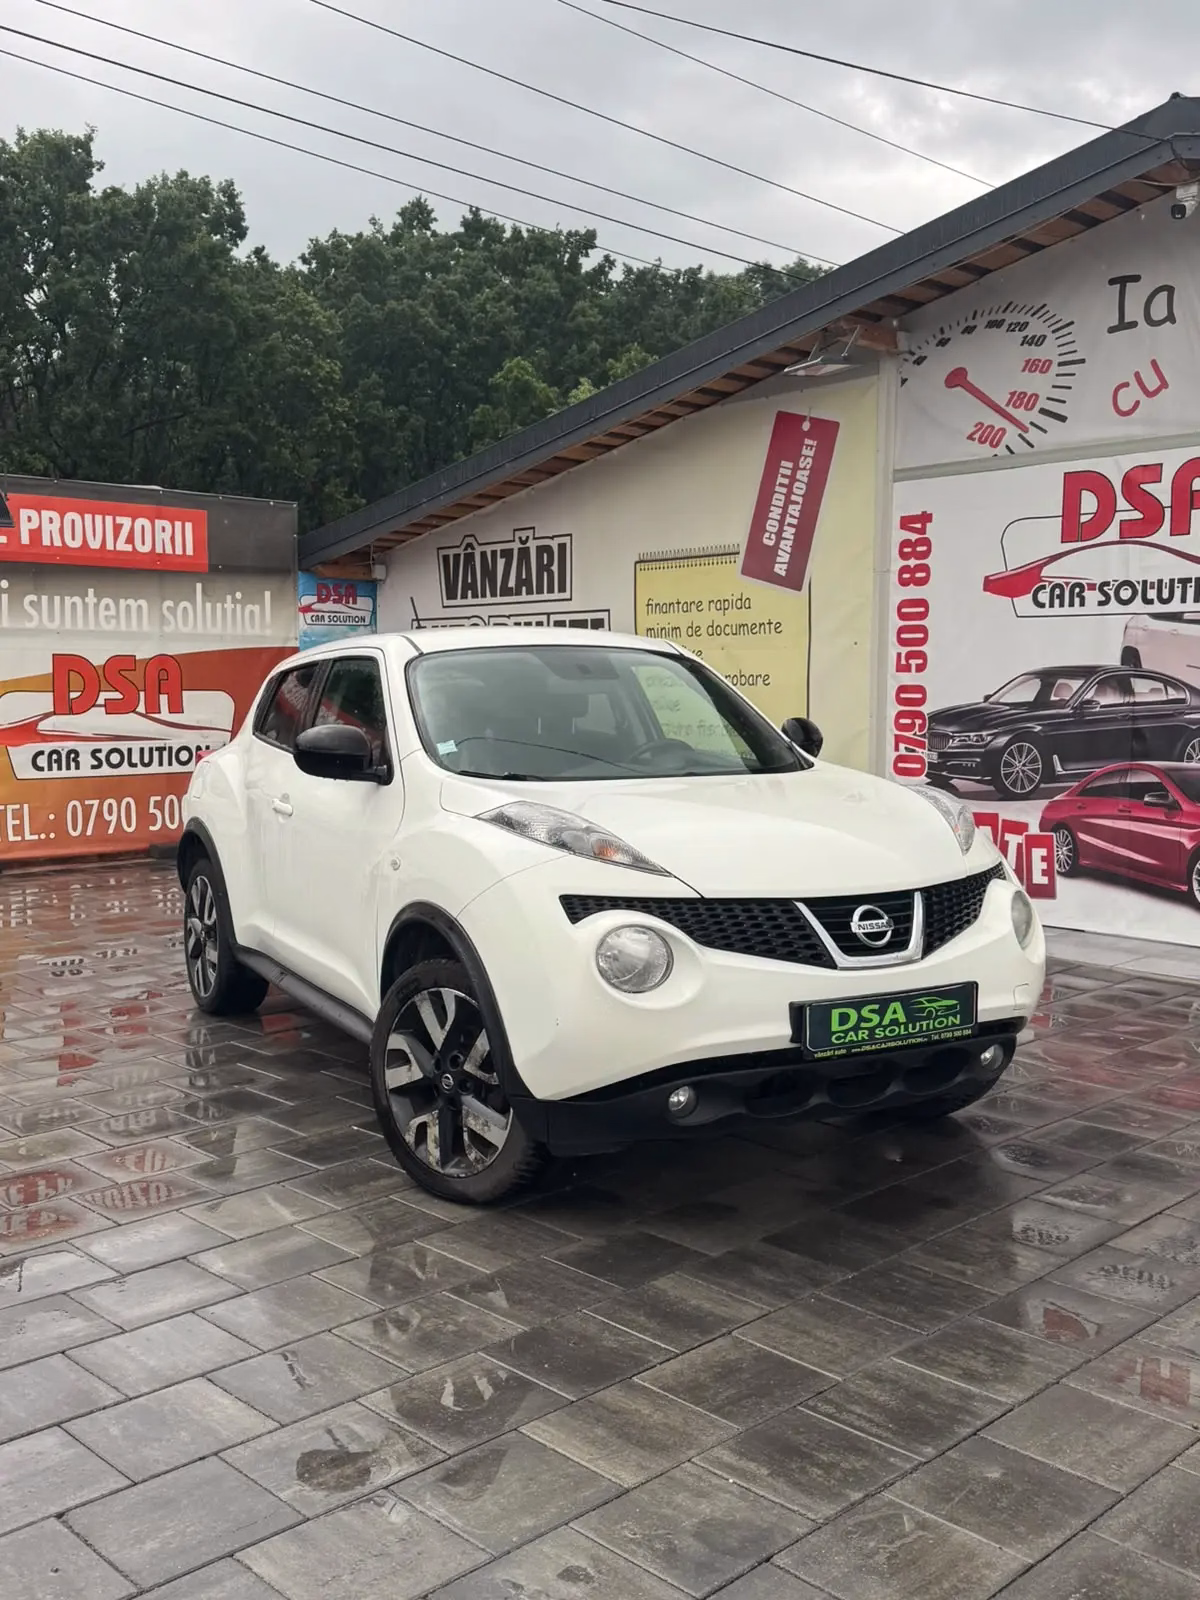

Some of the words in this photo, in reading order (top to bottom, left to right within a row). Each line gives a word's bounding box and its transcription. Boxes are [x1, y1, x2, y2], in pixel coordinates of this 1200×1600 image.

[1107, 274, 1177, 334] Ia
[1005, 321, 1029, 332] 120
[1020, 334, 1047, 347] 140
[1021, 358, 1053, 374] 160
[1005, 391, 1040, 411] 180
[1112, 358, 1169, 417] cu
[966, 421, 1007, 449] 200
[763, 460, 794, 547] CONDITII
[773, 438, 817, 577] AVANTAJOASE!
[1061, 456, 1200, 543] DSA
[20, 508, 194, 556] PROVIZORII
[897, 510, 933, 587] 884
[442, 535, 567, 600] VÂNZĂRI
[23, 588, 149, 631] suntem
[162, 583, 271, 635] solutia!
[316, 583, 357, 605] DSA
[645, 597, 704, 615] finantare
[708, 592, 752, 616] rapida
[1032, 582, 1086, 608] CAR
[310, 614, 325, 624] CAR
[328, 614, 366, 623] SOLUTION
[646, 622, 682, 639] minim
[686, 620, 703, 637] de
[706, 619, 783, 637] documente
[895, 598, 930, 674] 500
[52, 653, 184, 715] DSA
[893, 684, 928, 778] 0790
[31, 747, 81, 772] CAR
[66, 796, 137, 837] 0790
[149, 794, 185, 831] 50
[857, 921, 892, 931] NISSAN
[831, 1001, 907, 1031] DSA
[831, 1029, 870, 1044] CAR
[874, 1014, 960, 1038] SOLUTION
